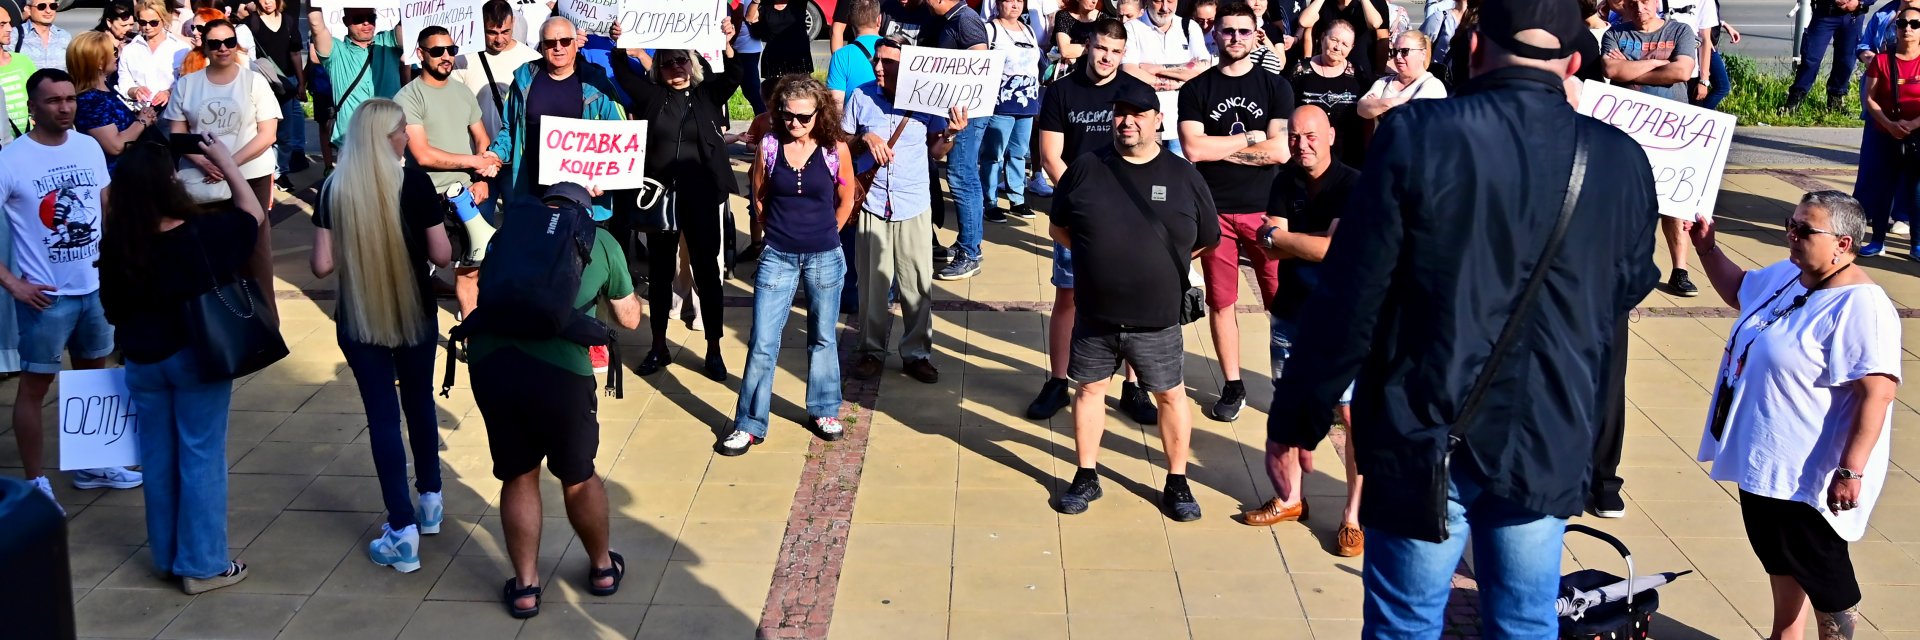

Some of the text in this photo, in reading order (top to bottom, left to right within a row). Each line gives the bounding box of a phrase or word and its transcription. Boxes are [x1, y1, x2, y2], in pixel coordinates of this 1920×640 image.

[405, 0, 445, 18] СТИГА
[423, 6, 473, 27] ТОЛКОВА
[570, 0, 597, 19] ГРАД
[909, 55, 991, 76] ОСТАВКА
[201, 101, 227, 125] So
[1209, 96, 1264, 121] MONCLER
[1592, 94, 1717, 151] ОСТАВКА
[546, 129, 640, 153] ОСТАВКА
[33, 169, 95, 199] WARRIOR
[546, 213, 560, 235] THULE
[63, 394, 138, 446] ОСТА
